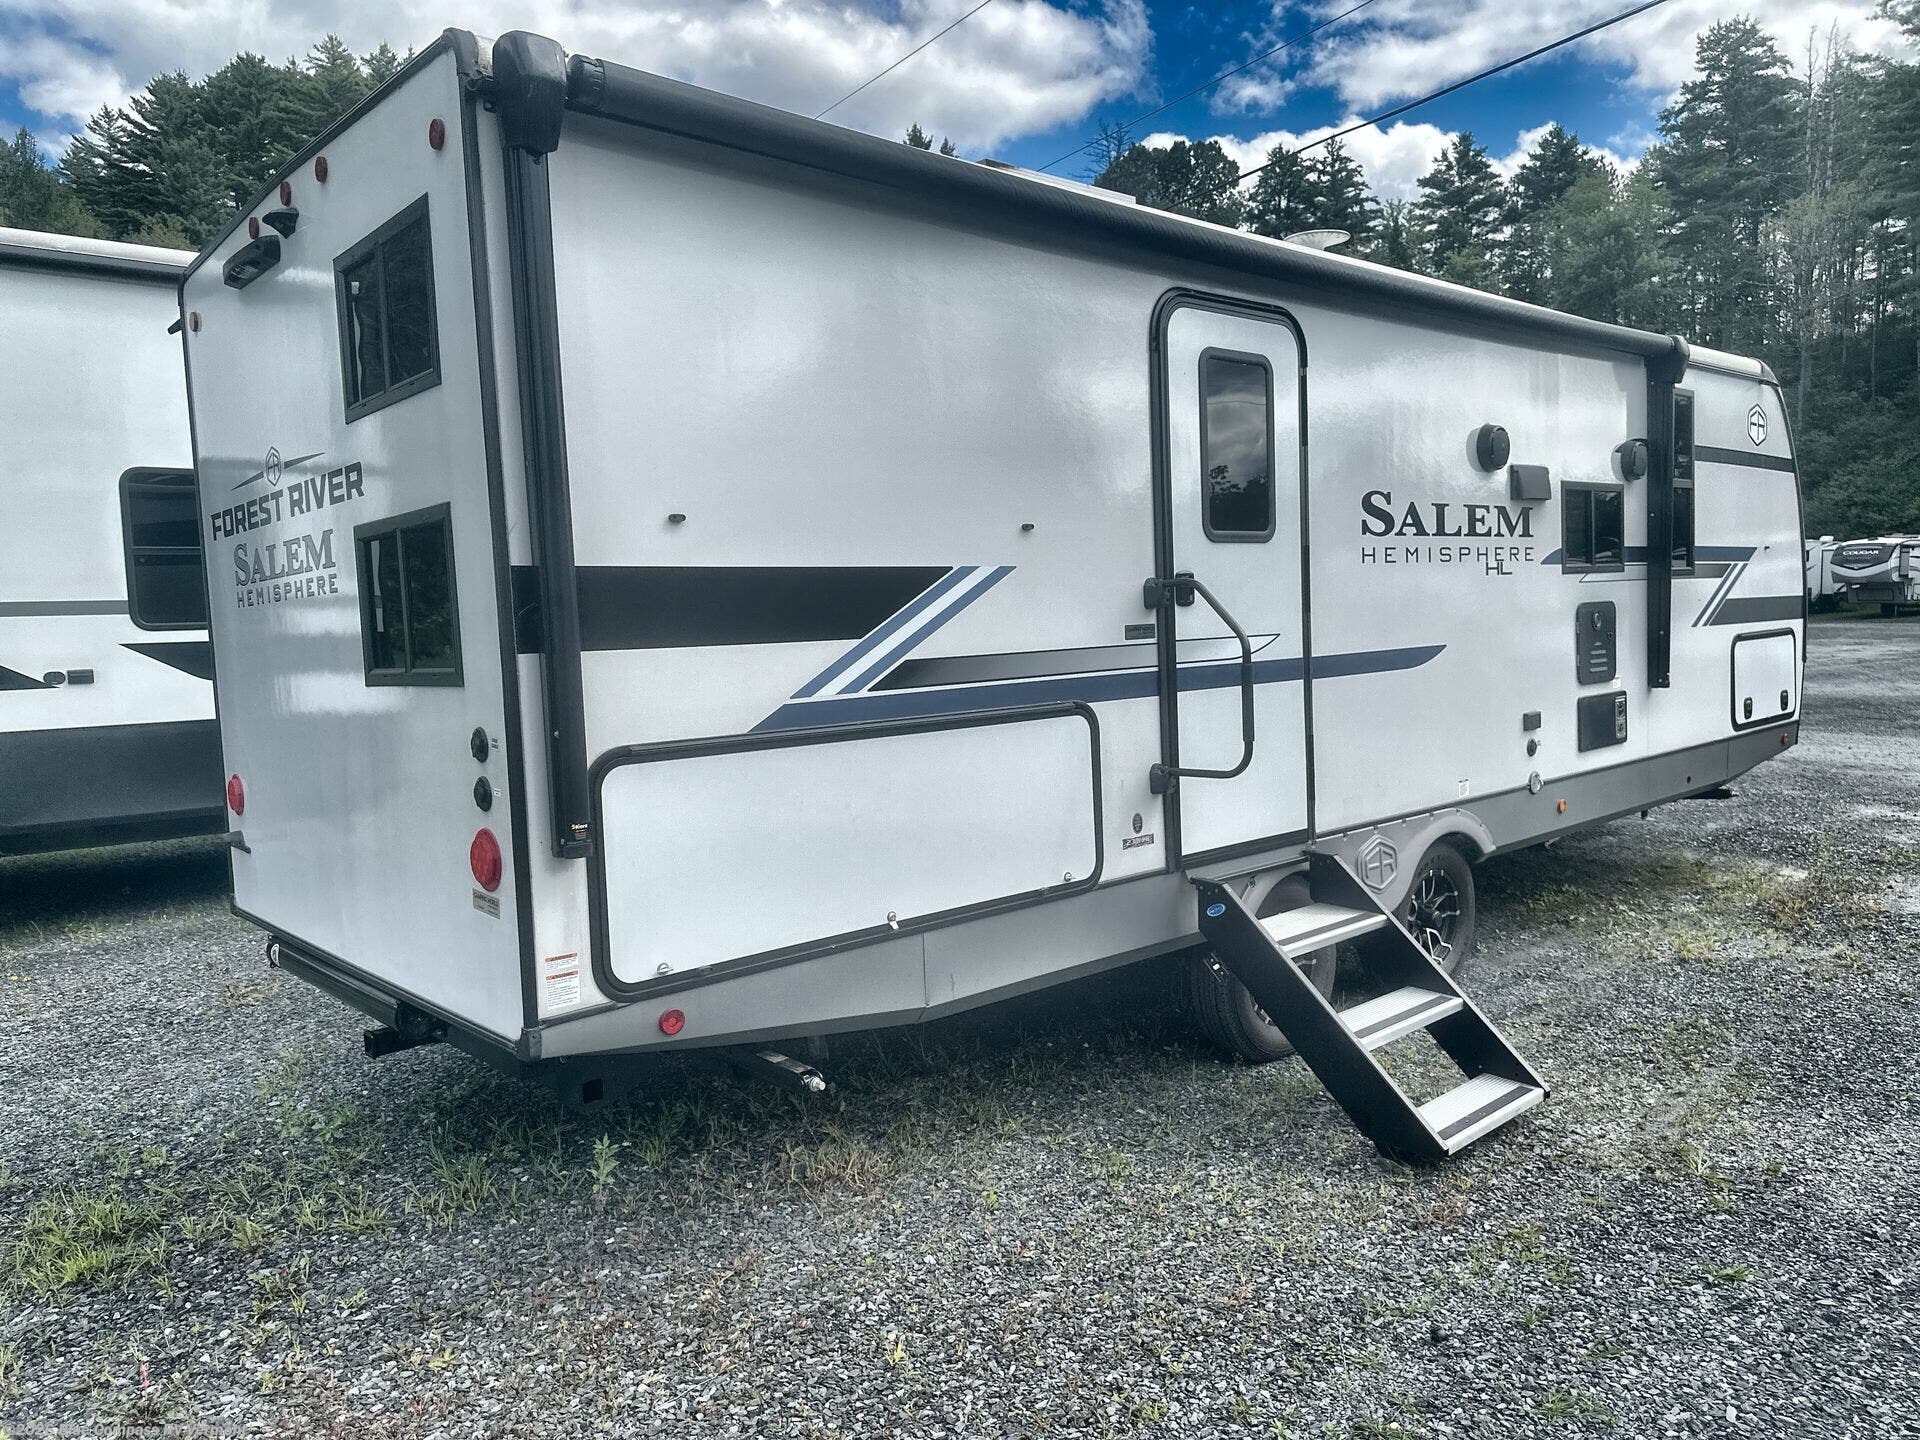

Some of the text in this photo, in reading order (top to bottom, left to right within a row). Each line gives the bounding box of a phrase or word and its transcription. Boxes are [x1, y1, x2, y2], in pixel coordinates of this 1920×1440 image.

[211, 461, 365, 541] FOREST RIVER
[1361, 490, 1534, 538] SALEM
[233, 528, 337, 587] SALEM
[1361, 547, 1534, 564] HEMISPHERE
[1485, 561, 1513, 576] HL
[236, 573, 339, 609] HEMISPHERE
